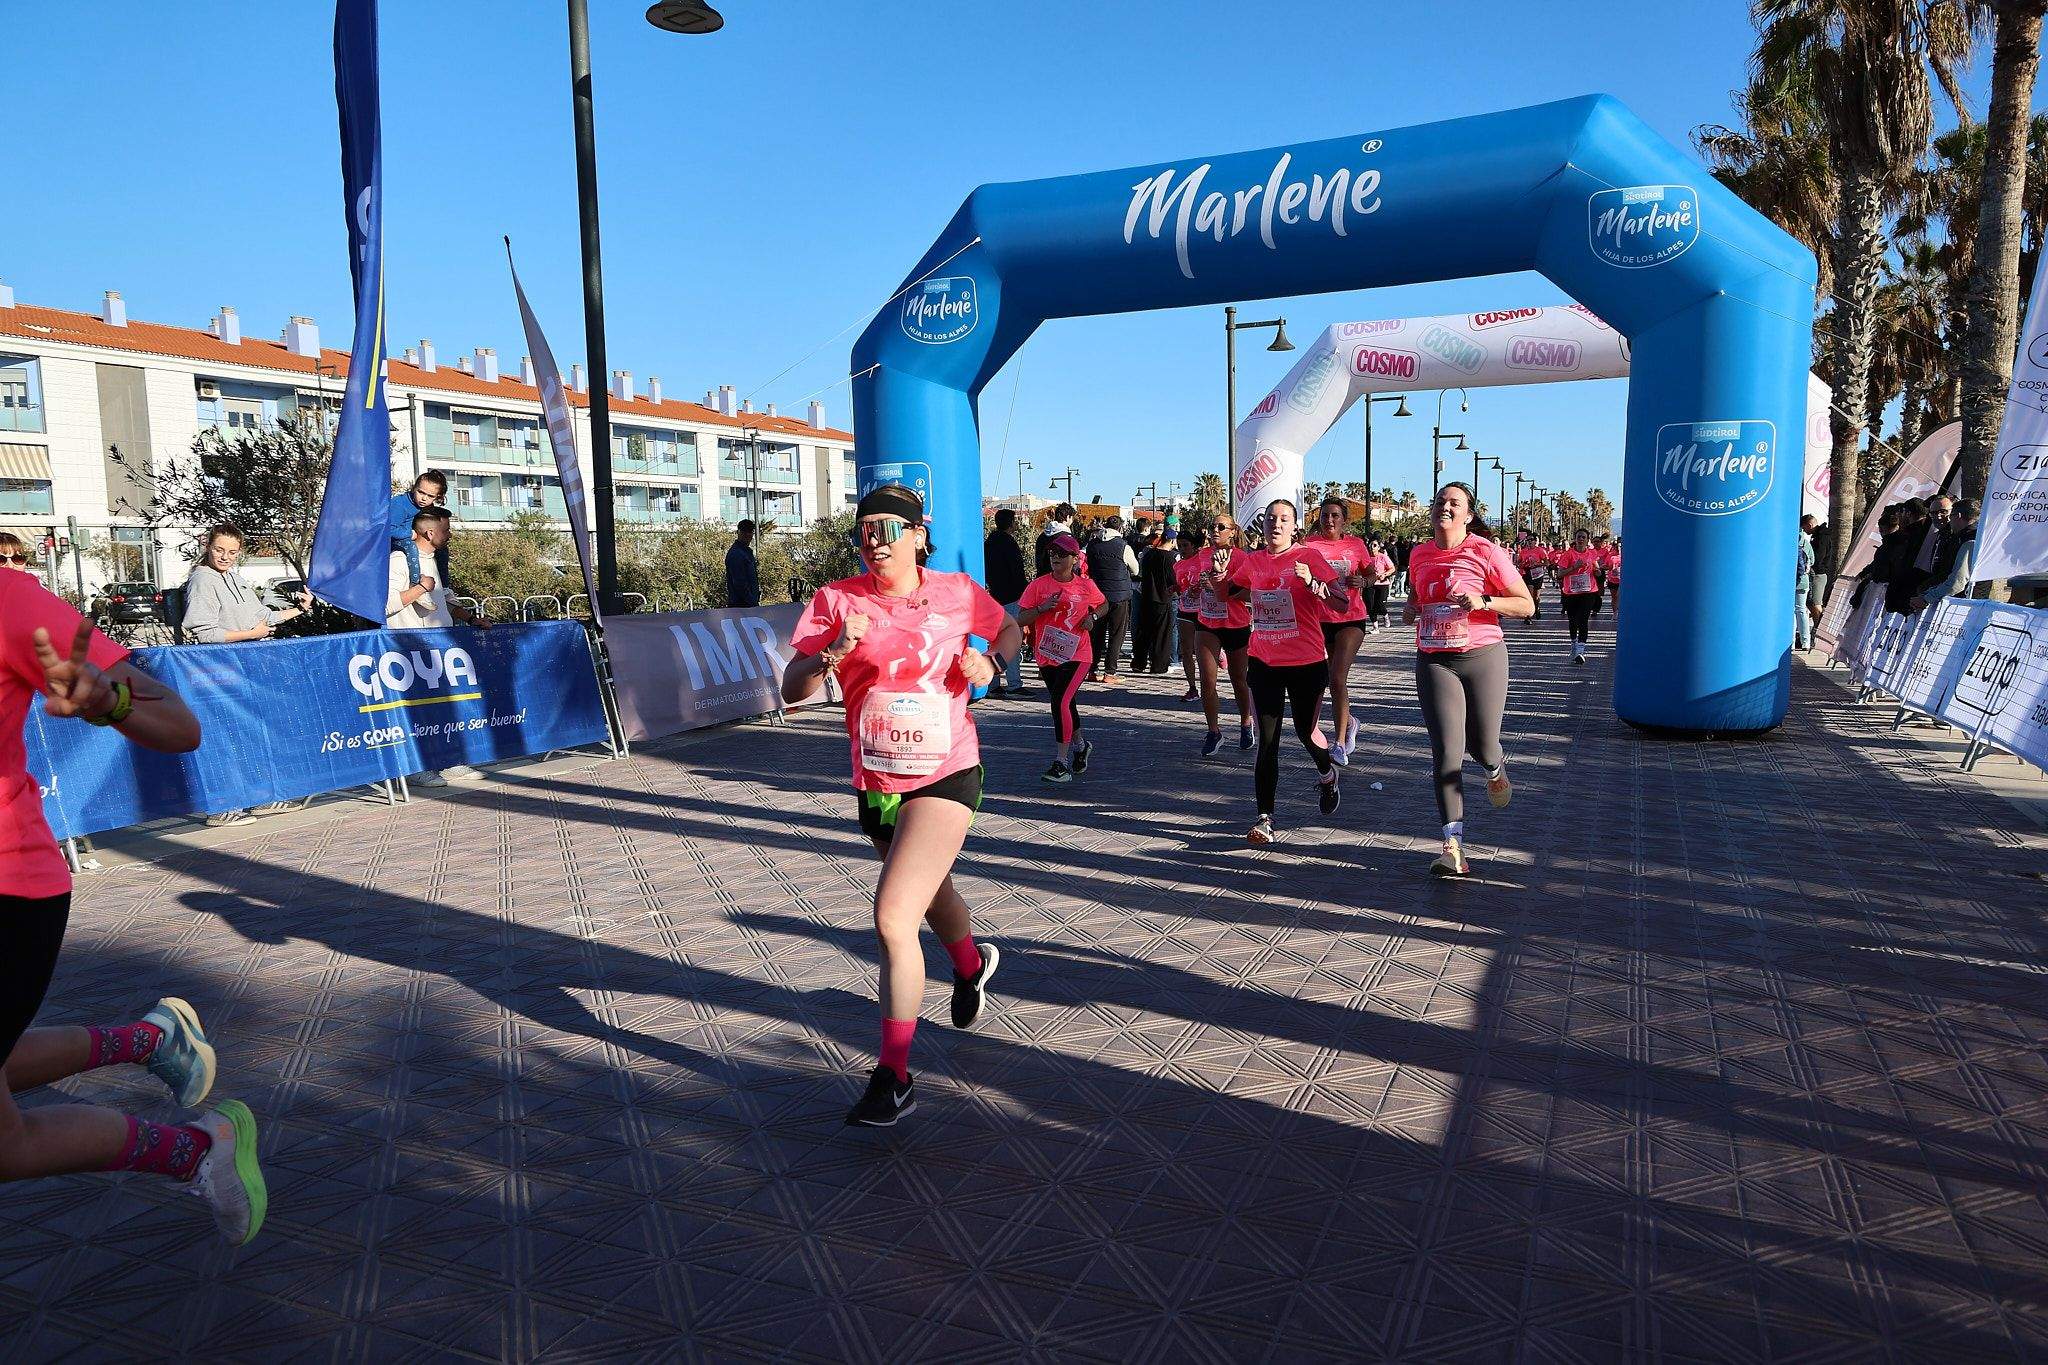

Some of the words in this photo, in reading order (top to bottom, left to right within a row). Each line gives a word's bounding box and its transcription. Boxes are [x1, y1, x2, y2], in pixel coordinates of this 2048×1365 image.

[1124, 152, 1381, 279] Marlene
[1596, 202, 1692, 248] Marlene
[1602, 248, 1620, 262] HIJA
[1622, 255, 1634, 264] DE
[1636, 254, 1654, 263] LOS
[1656, 239, 1684, 259] ALPES
[906, 292, 972, 327] Marlene
[1474, 307, 1537, 326] COSMO
[908, 325, 922, 338] HIJA
[934, 332, 948, 340] LOS
[948, 323, 968, 338] ALPES
[1343, 319, 1400, 337] COSMO
[1424, 327, 1482, 370] COSMO
[1511, 340, 1576, 368] COSMO
[1356, 349, 1415, 378] COSMO
[1236, 455, 1277, 502] COSMO
[1662, 442, 1767, 490] Marlene
[1666, 488, 1685, 505] HIJA
[1687, 499, 1702, 509] DE
[1704, 500, 1725, 510] LOS
[1727, 489, 1758, 508] ALPES
[1434, 622, 1452, 630] 016
[669, 616, 790, 690] IMR
[1051, 642, 1065, 652] 016
[348, 647, 478, 701] GOYA
[347, 735, 361, 748] es
[363, 726, 405, 746] GOYA
[443, 718, 465, 743] que
[467, 716, 488, 731] ser
[491, 708, 527, 728] bueno!
[889, 729, 924, 743] 016
[871, 759, 897, 769] OYSHO
